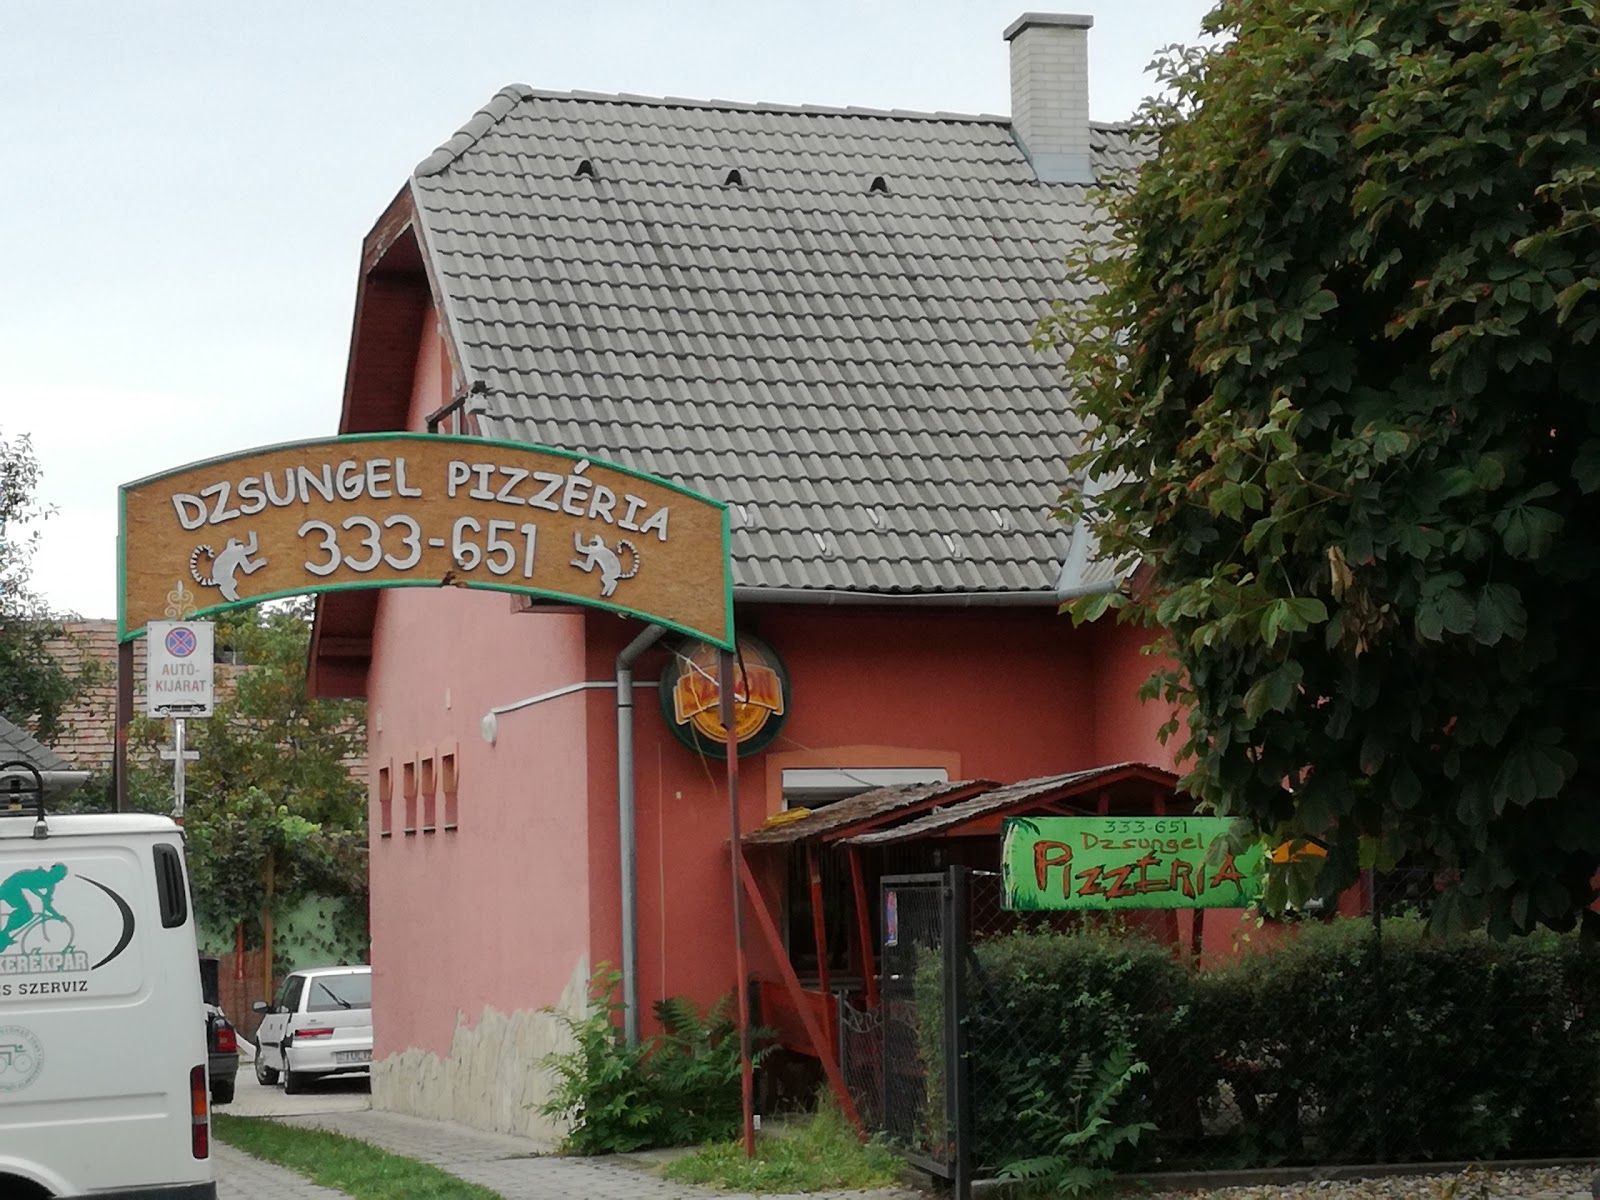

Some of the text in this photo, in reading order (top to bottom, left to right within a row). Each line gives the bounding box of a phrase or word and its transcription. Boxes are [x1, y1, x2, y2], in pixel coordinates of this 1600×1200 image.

[172, 457, 670, 542] DZSUNGEL PIZZÉRIA
[297, 514, 538, 578] 333-651
[155, 679, 207, 692] KIJÁRAT
[1033, 840, 1247, 902] PIZZÉRIA
[0, 980, 88, 996] S SZERVIZ
